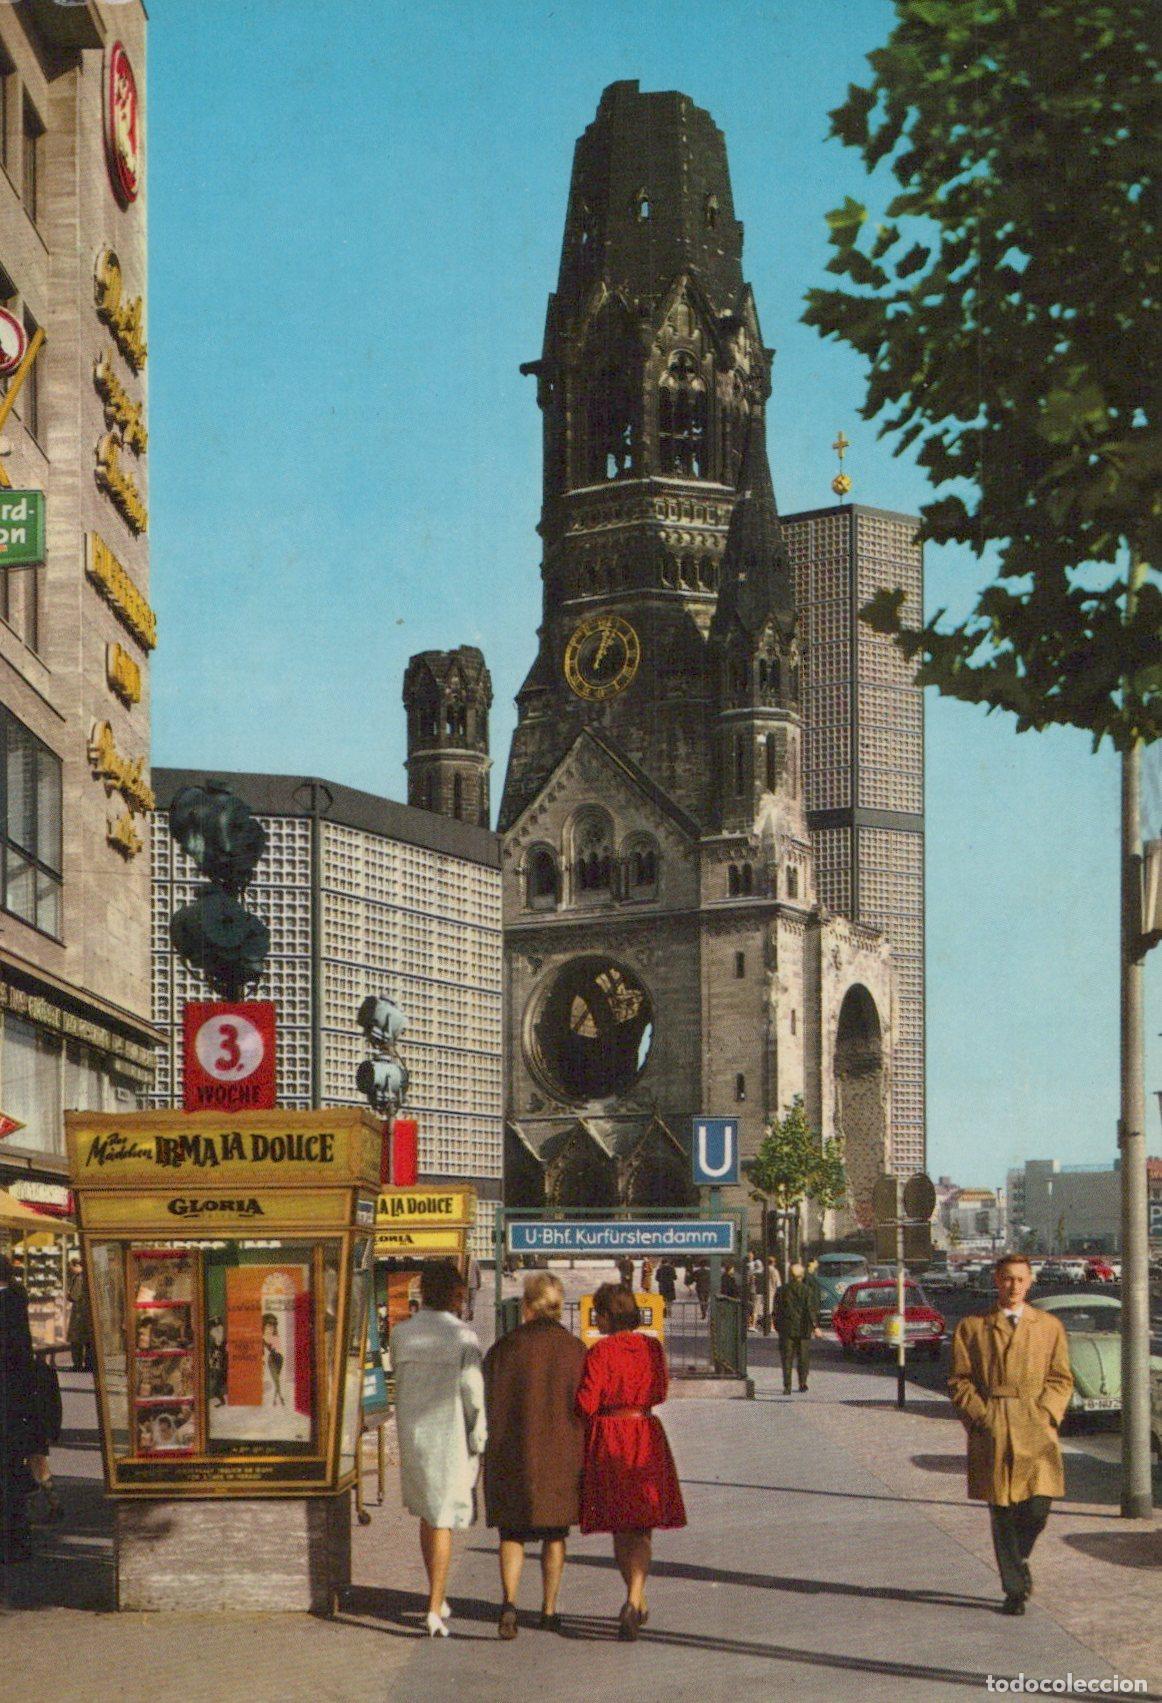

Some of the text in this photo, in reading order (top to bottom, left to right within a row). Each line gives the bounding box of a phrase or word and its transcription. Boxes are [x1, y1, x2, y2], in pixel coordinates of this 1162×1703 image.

[214, 1023, 245, 1072] 3.
[197, 1084, 261, 1105] WOCHE
[154, 1134, 221, 1168] IRMA
[251, 1133, 336, 1163] DOUCE
[698, 1125, 733, 1178] U
[167, 1198, 265, 1215] GLORIA
[407, 1197, 454, 1214] DOUCE
[524, 1228, 719, 1245] U-Bhf. Kurfürstendamm
